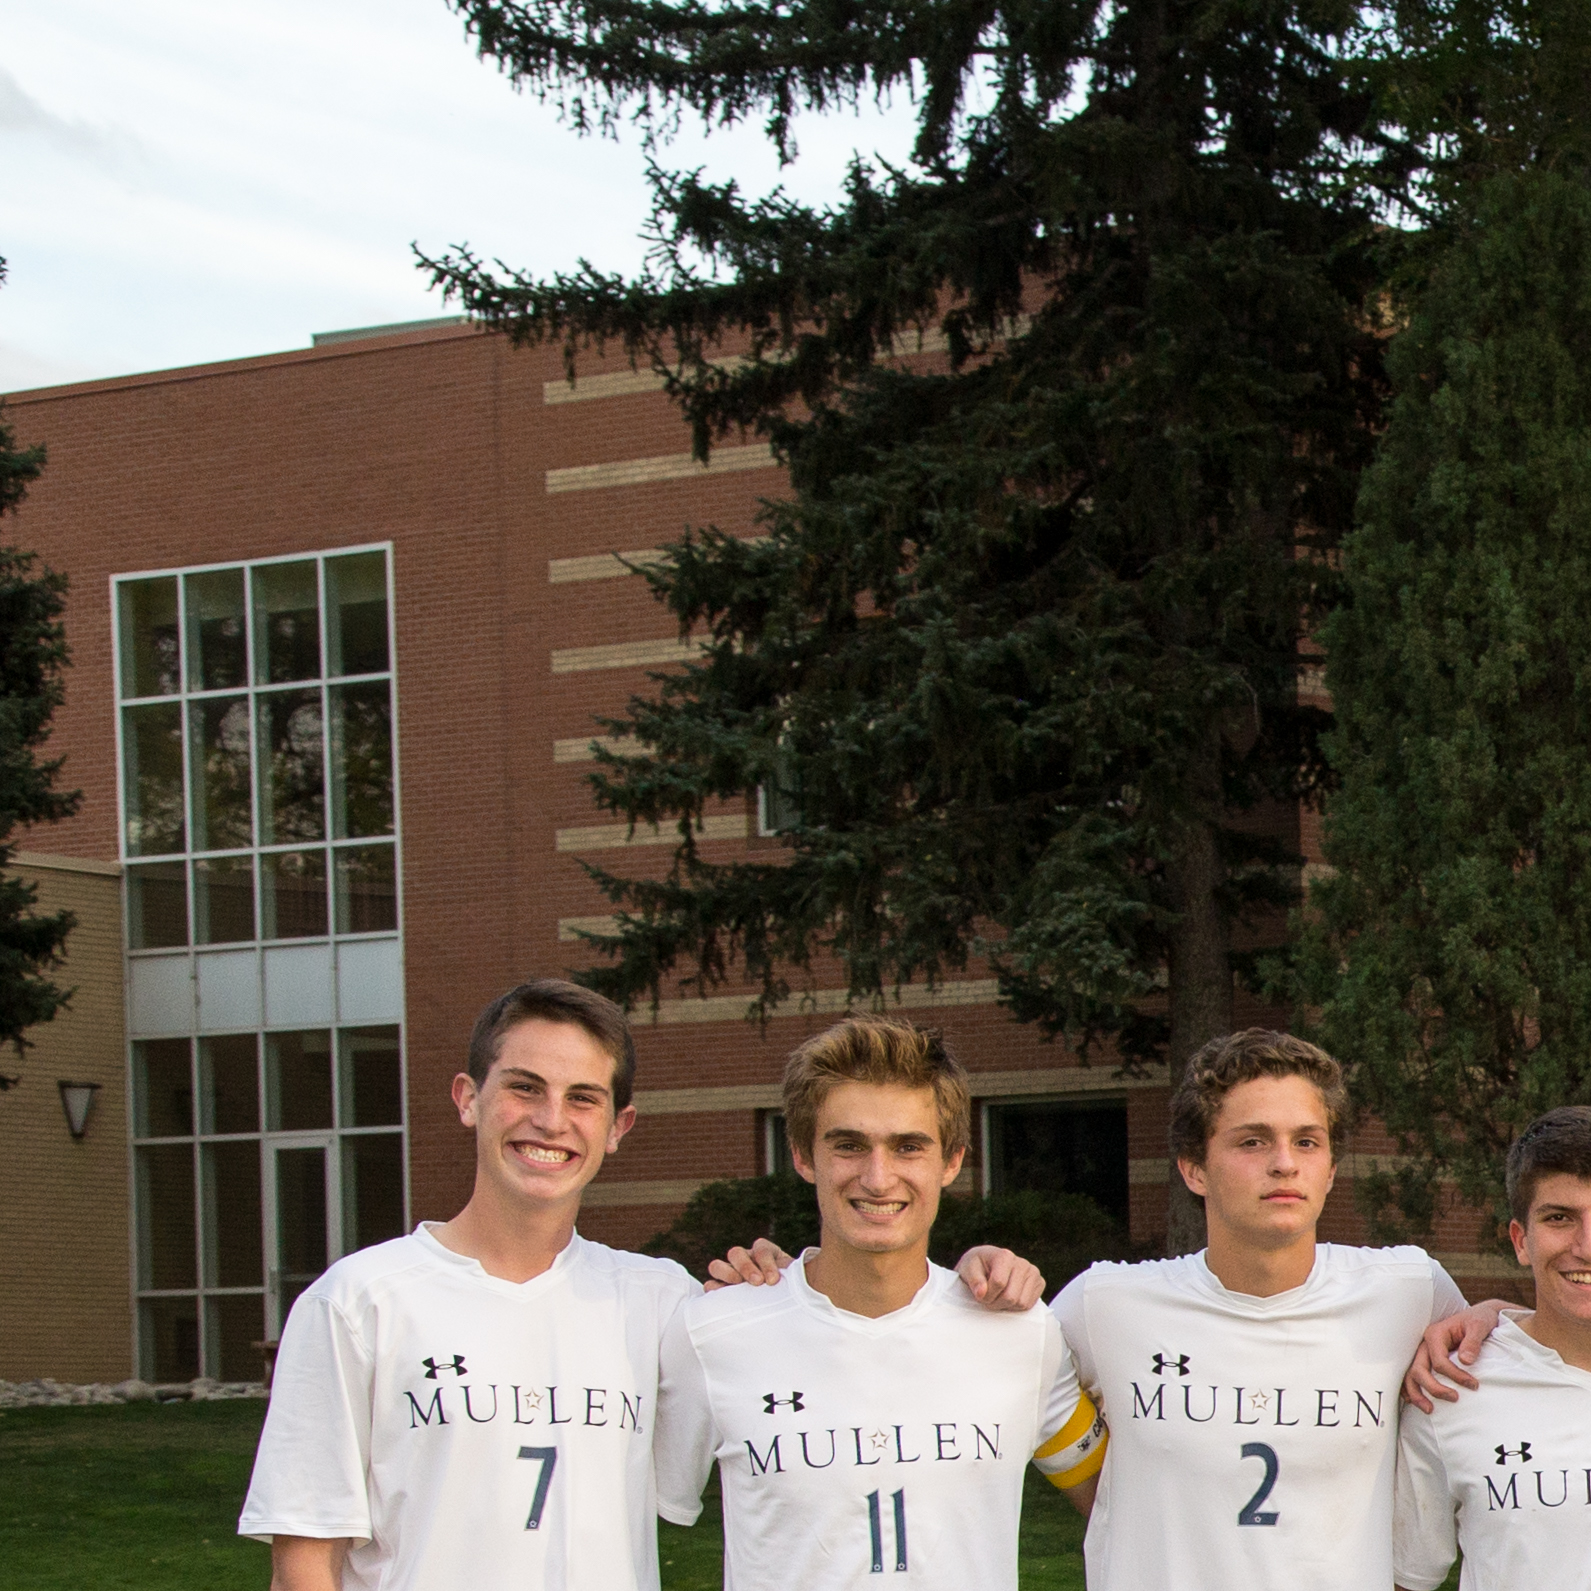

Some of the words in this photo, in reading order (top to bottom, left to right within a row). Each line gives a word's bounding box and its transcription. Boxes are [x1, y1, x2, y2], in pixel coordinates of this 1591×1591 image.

[404, 1386, 641, 1431] MULLEN
[1131, 1382, 1382, 1427] MULLEN
[744, 1423, 1001, 1476] MULLEN
[518, 1447, 556, 1529] 7
[1239, 1443, 1278, 1525] 2
[867, 1489, 906, 1572] 11
